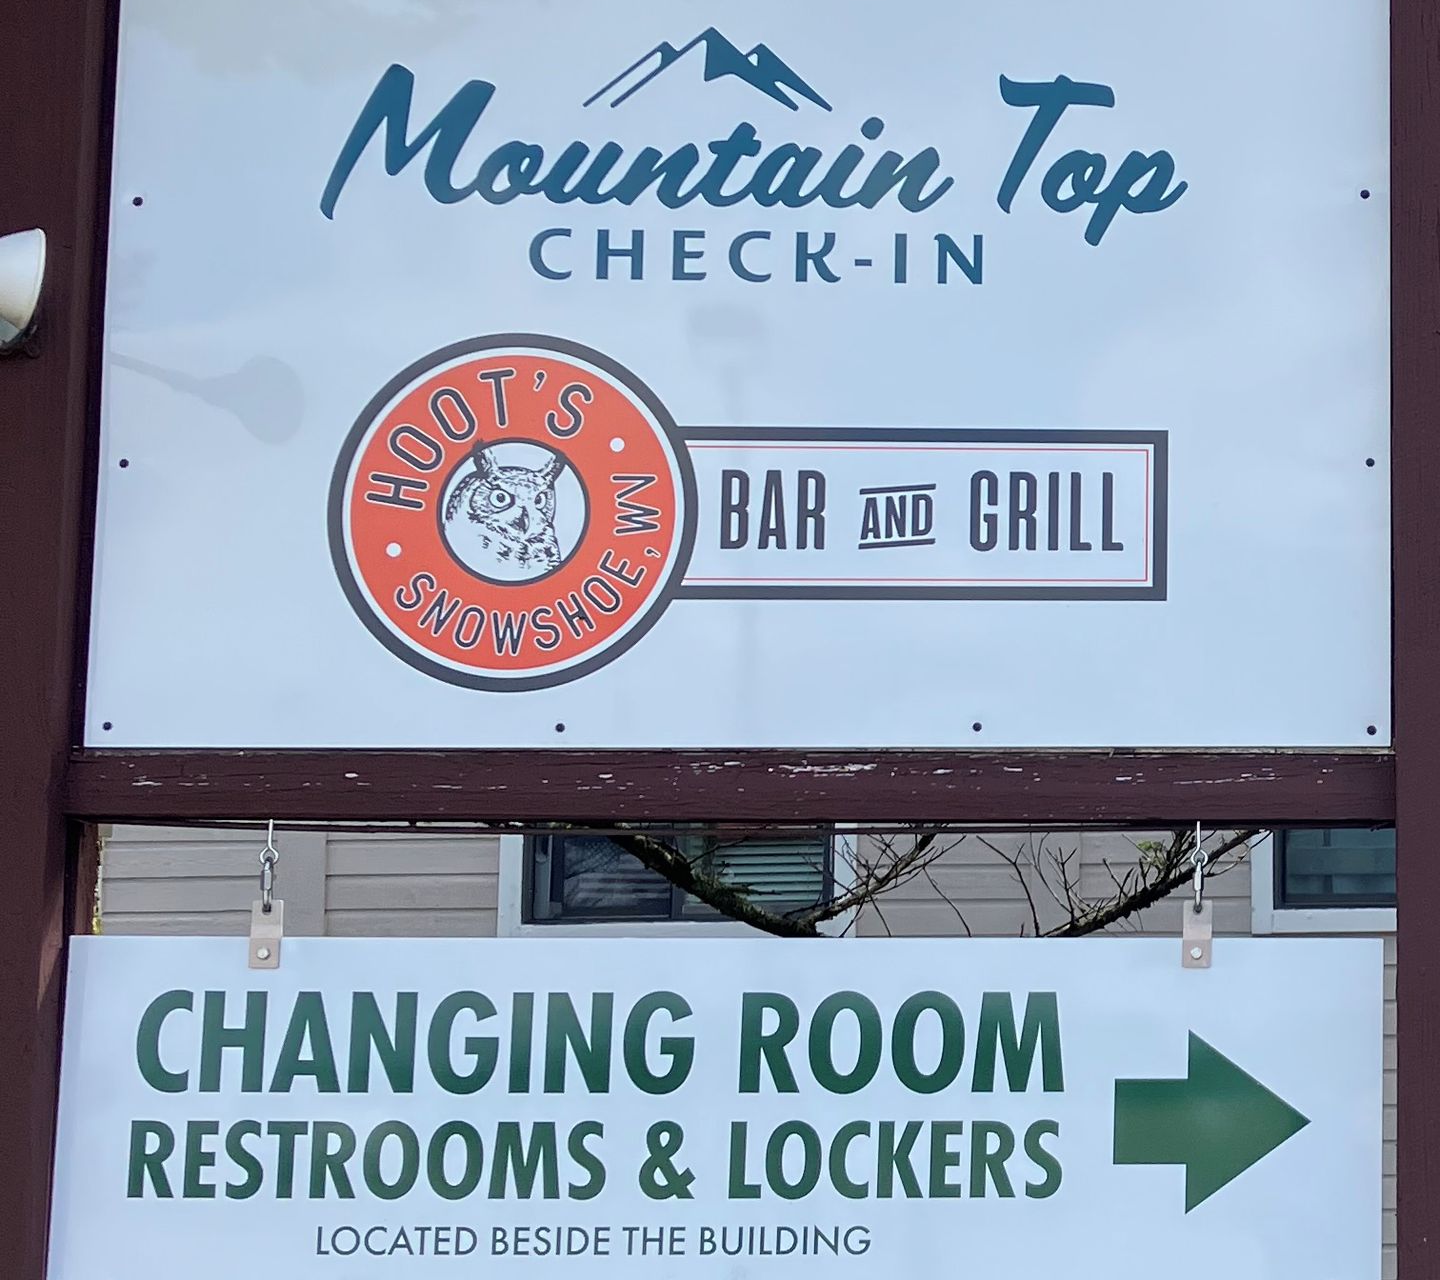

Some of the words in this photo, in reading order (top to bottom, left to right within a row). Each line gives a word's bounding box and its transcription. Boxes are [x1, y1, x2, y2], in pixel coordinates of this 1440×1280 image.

[319, 62, 954, 220] Mountain
[997, 74, 1188, 247] Top
[528, 227, 984, 285] CHECK-IN
[366, 368, 594, 510] HOOT'S
[719, 469, 826, 551] BAR
[858, 491, 937, 542] AND
[969, 470, 1124, 552] GRILL
[136, 989, 695, 1095] CHANGING
[738, 990, 1065, 1095] ROOM
[126, 1119, 607, 1201] RESTROOMS
[638, 1120, 696, 1201] &
[727, 1119, 1063, 1201] LOCKERS
[316, 1225, 478, 1256] LOCATED
[491, 1226, 611, 1256] BESIDE
[622, 1226, 686, 1256] THE
[699, 1225, 871, 1256] BUILDING
